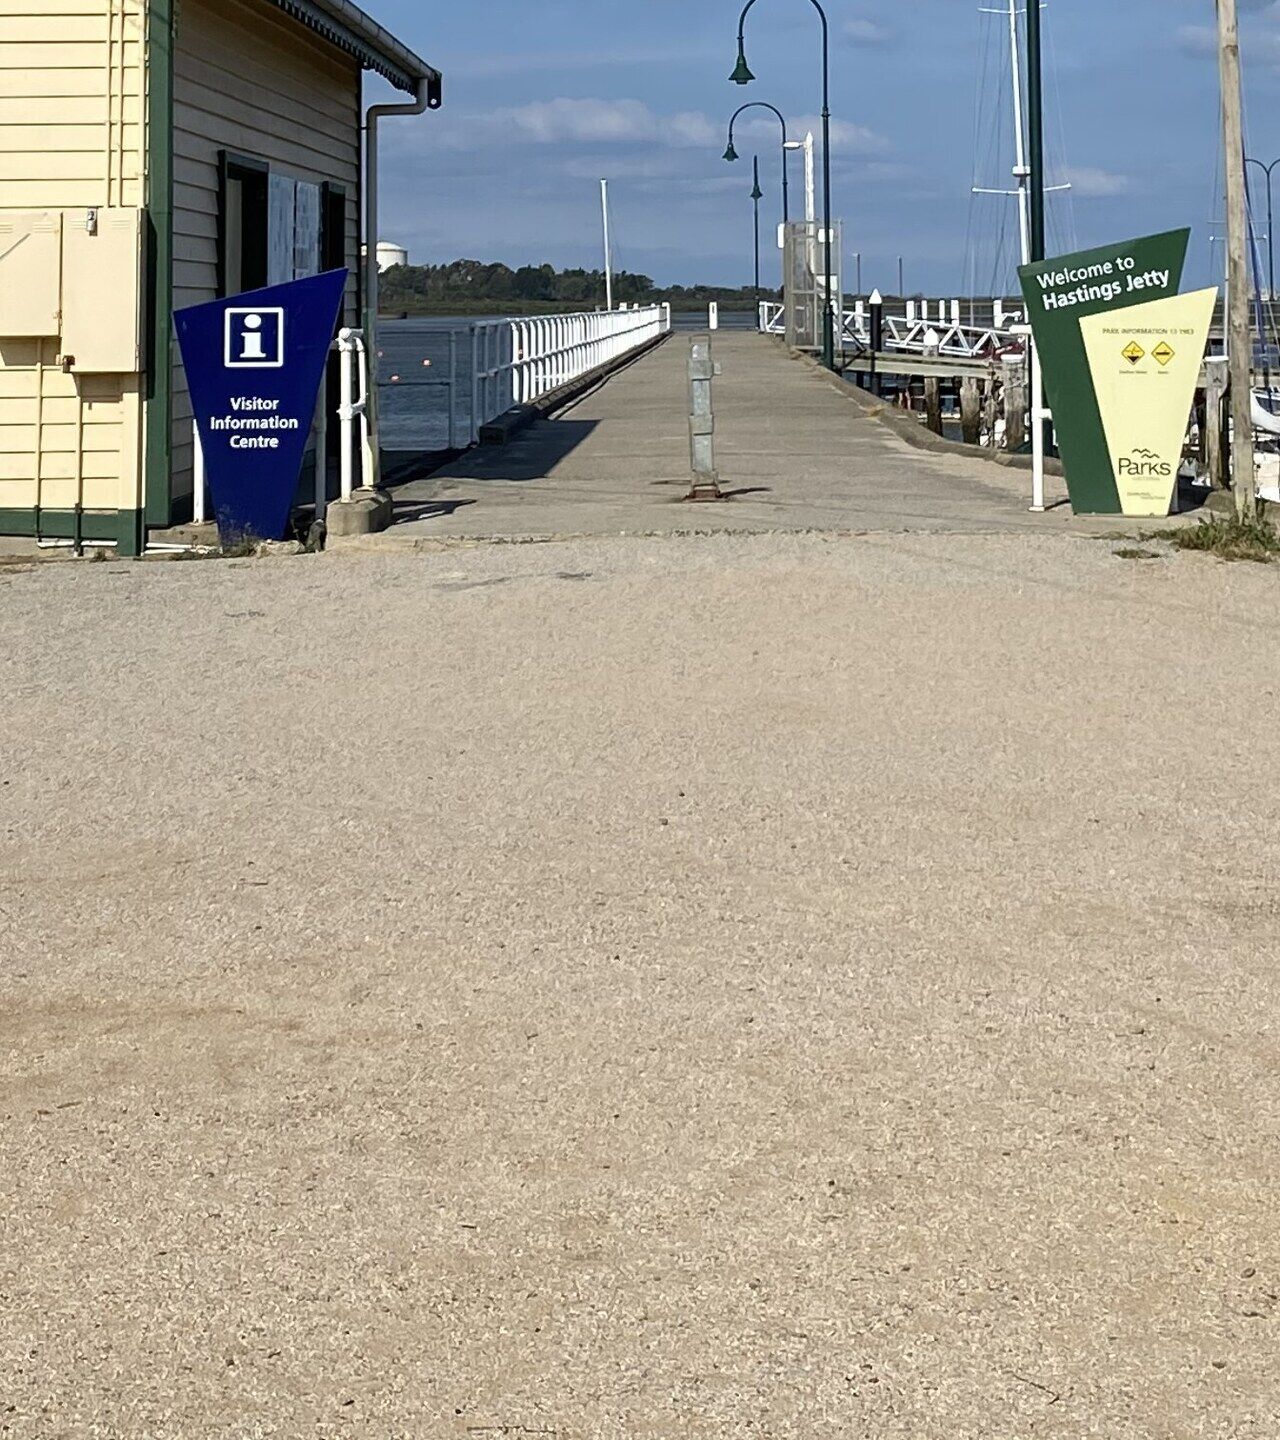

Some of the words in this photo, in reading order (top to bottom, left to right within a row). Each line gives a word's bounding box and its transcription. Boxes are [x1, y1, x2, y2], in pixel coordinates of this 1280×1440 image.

[1036, 261, 1113, 289] Welcome
[1115, 256, 1135, 271] to
[1042, 284, 1122, 310] Hastings
[1126, 269, 1169, 292] Jetty
[230, 396, 280, 411] Visitor
[210, 415, 299, 430] Information
[229, 434, 280, 449] Centre
[1118, 457, 1171, 476] Parks
